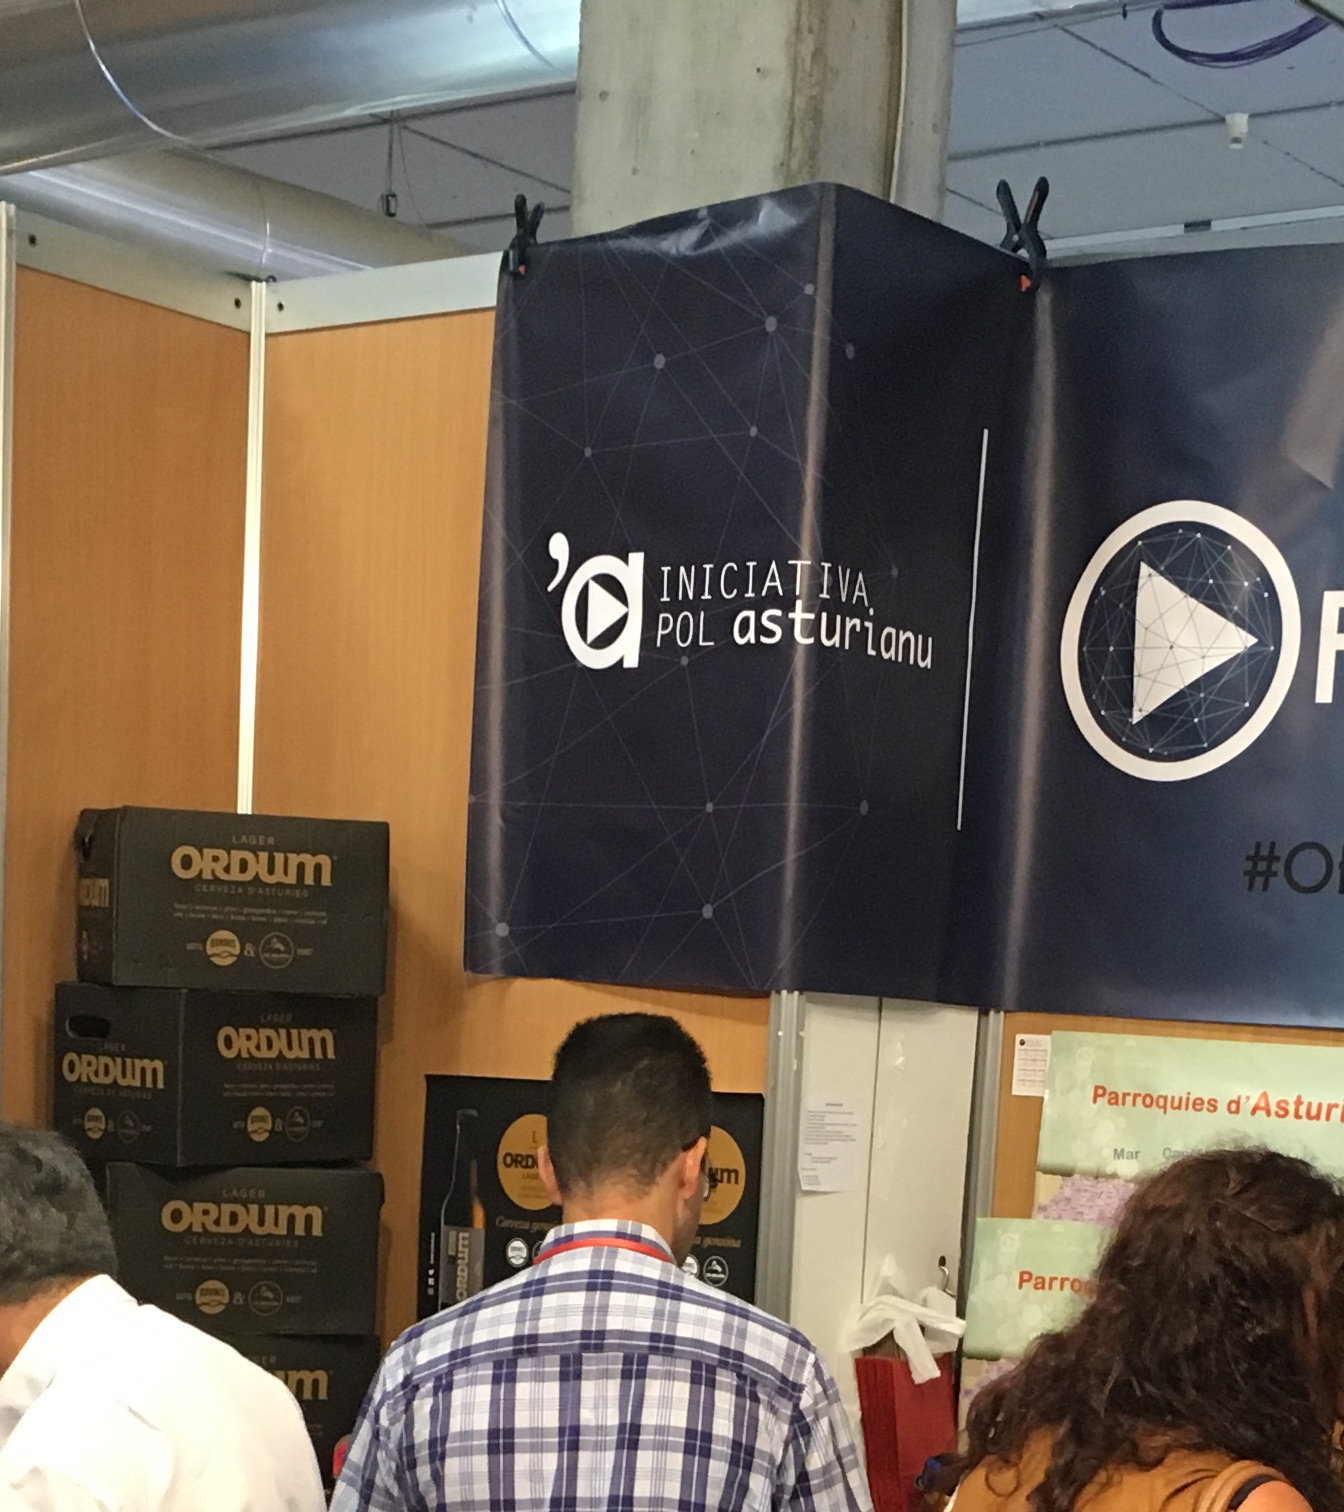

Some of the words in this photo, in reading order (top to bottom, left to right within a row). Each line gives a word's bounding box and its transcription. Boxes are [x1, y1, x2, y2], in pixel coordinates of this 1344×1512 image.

[659, 559, 870, 607] INICIATIVA
[656, 610, 715, 648] POL
[732, 600, 934, 670] asturianu
[231, 834, 276, 846] LAGER
[1092, 1084, 1219, 1115] Parroquies
[502, 1152, 539, 1169] ORD
[1112, 1147, 1141, 1161] Mar
[222, 1187, 267, 1199] LAGER
[1017, 1269, 1084, 1295] Parro
